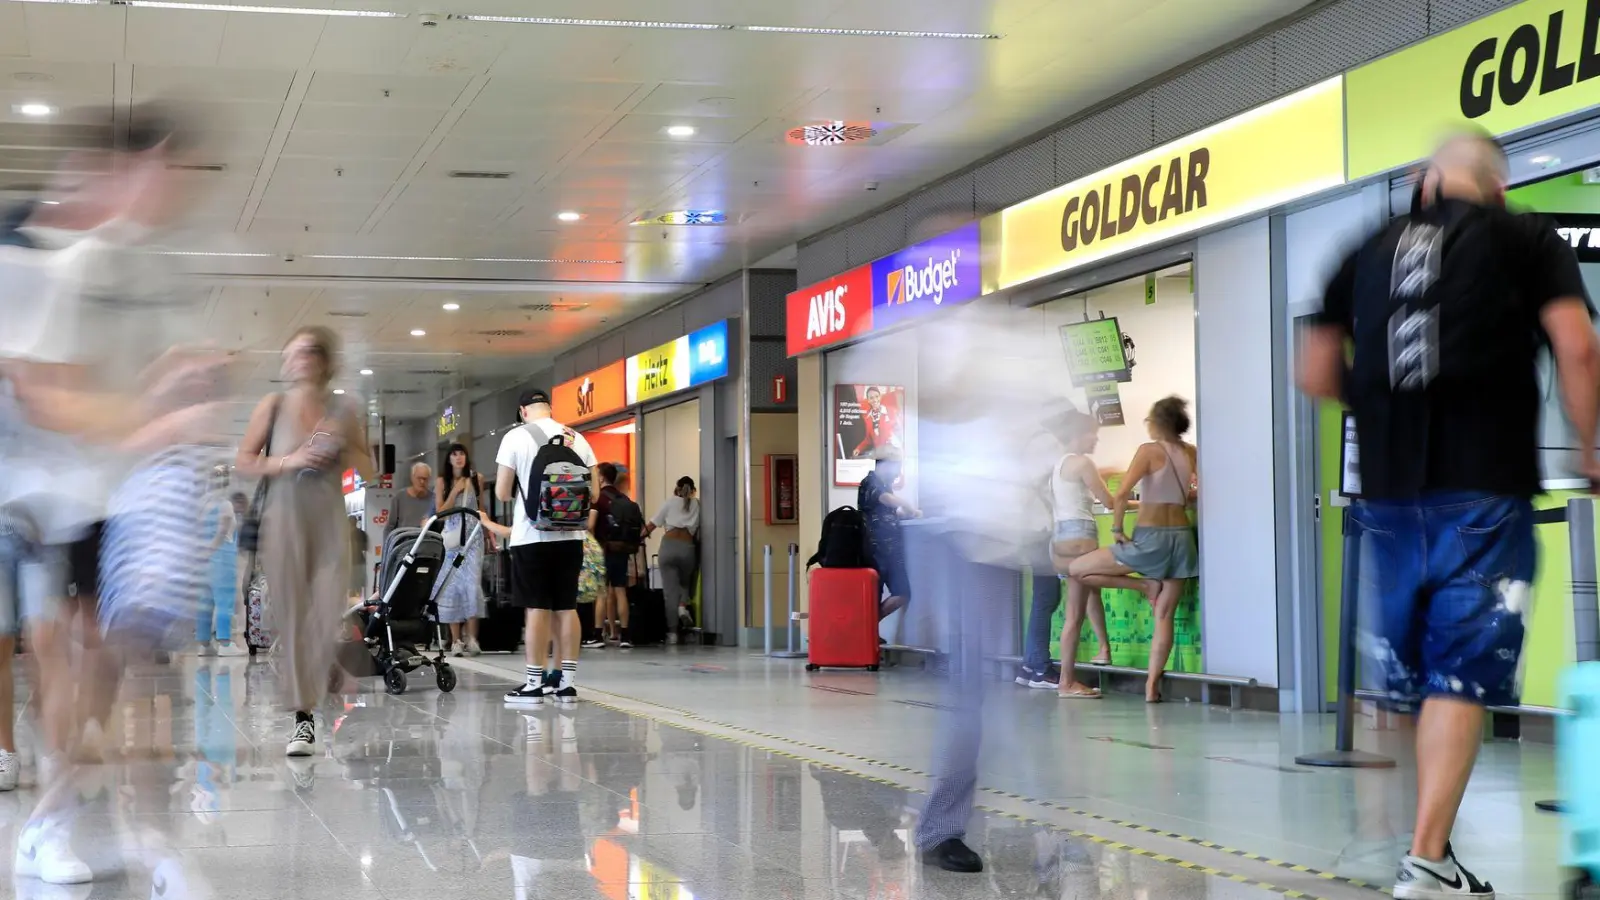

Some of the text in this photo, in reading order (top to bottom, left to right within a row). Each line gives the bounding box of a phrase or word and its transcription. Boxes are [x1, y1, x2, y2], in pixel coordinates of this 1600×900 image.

[1061, 147, 1210, 252] GOLDCAR
[905, 250, 958, 305] Budget
[806, 285, 846, 340] AVIS
[644, 355, 667, 391] Hertz
